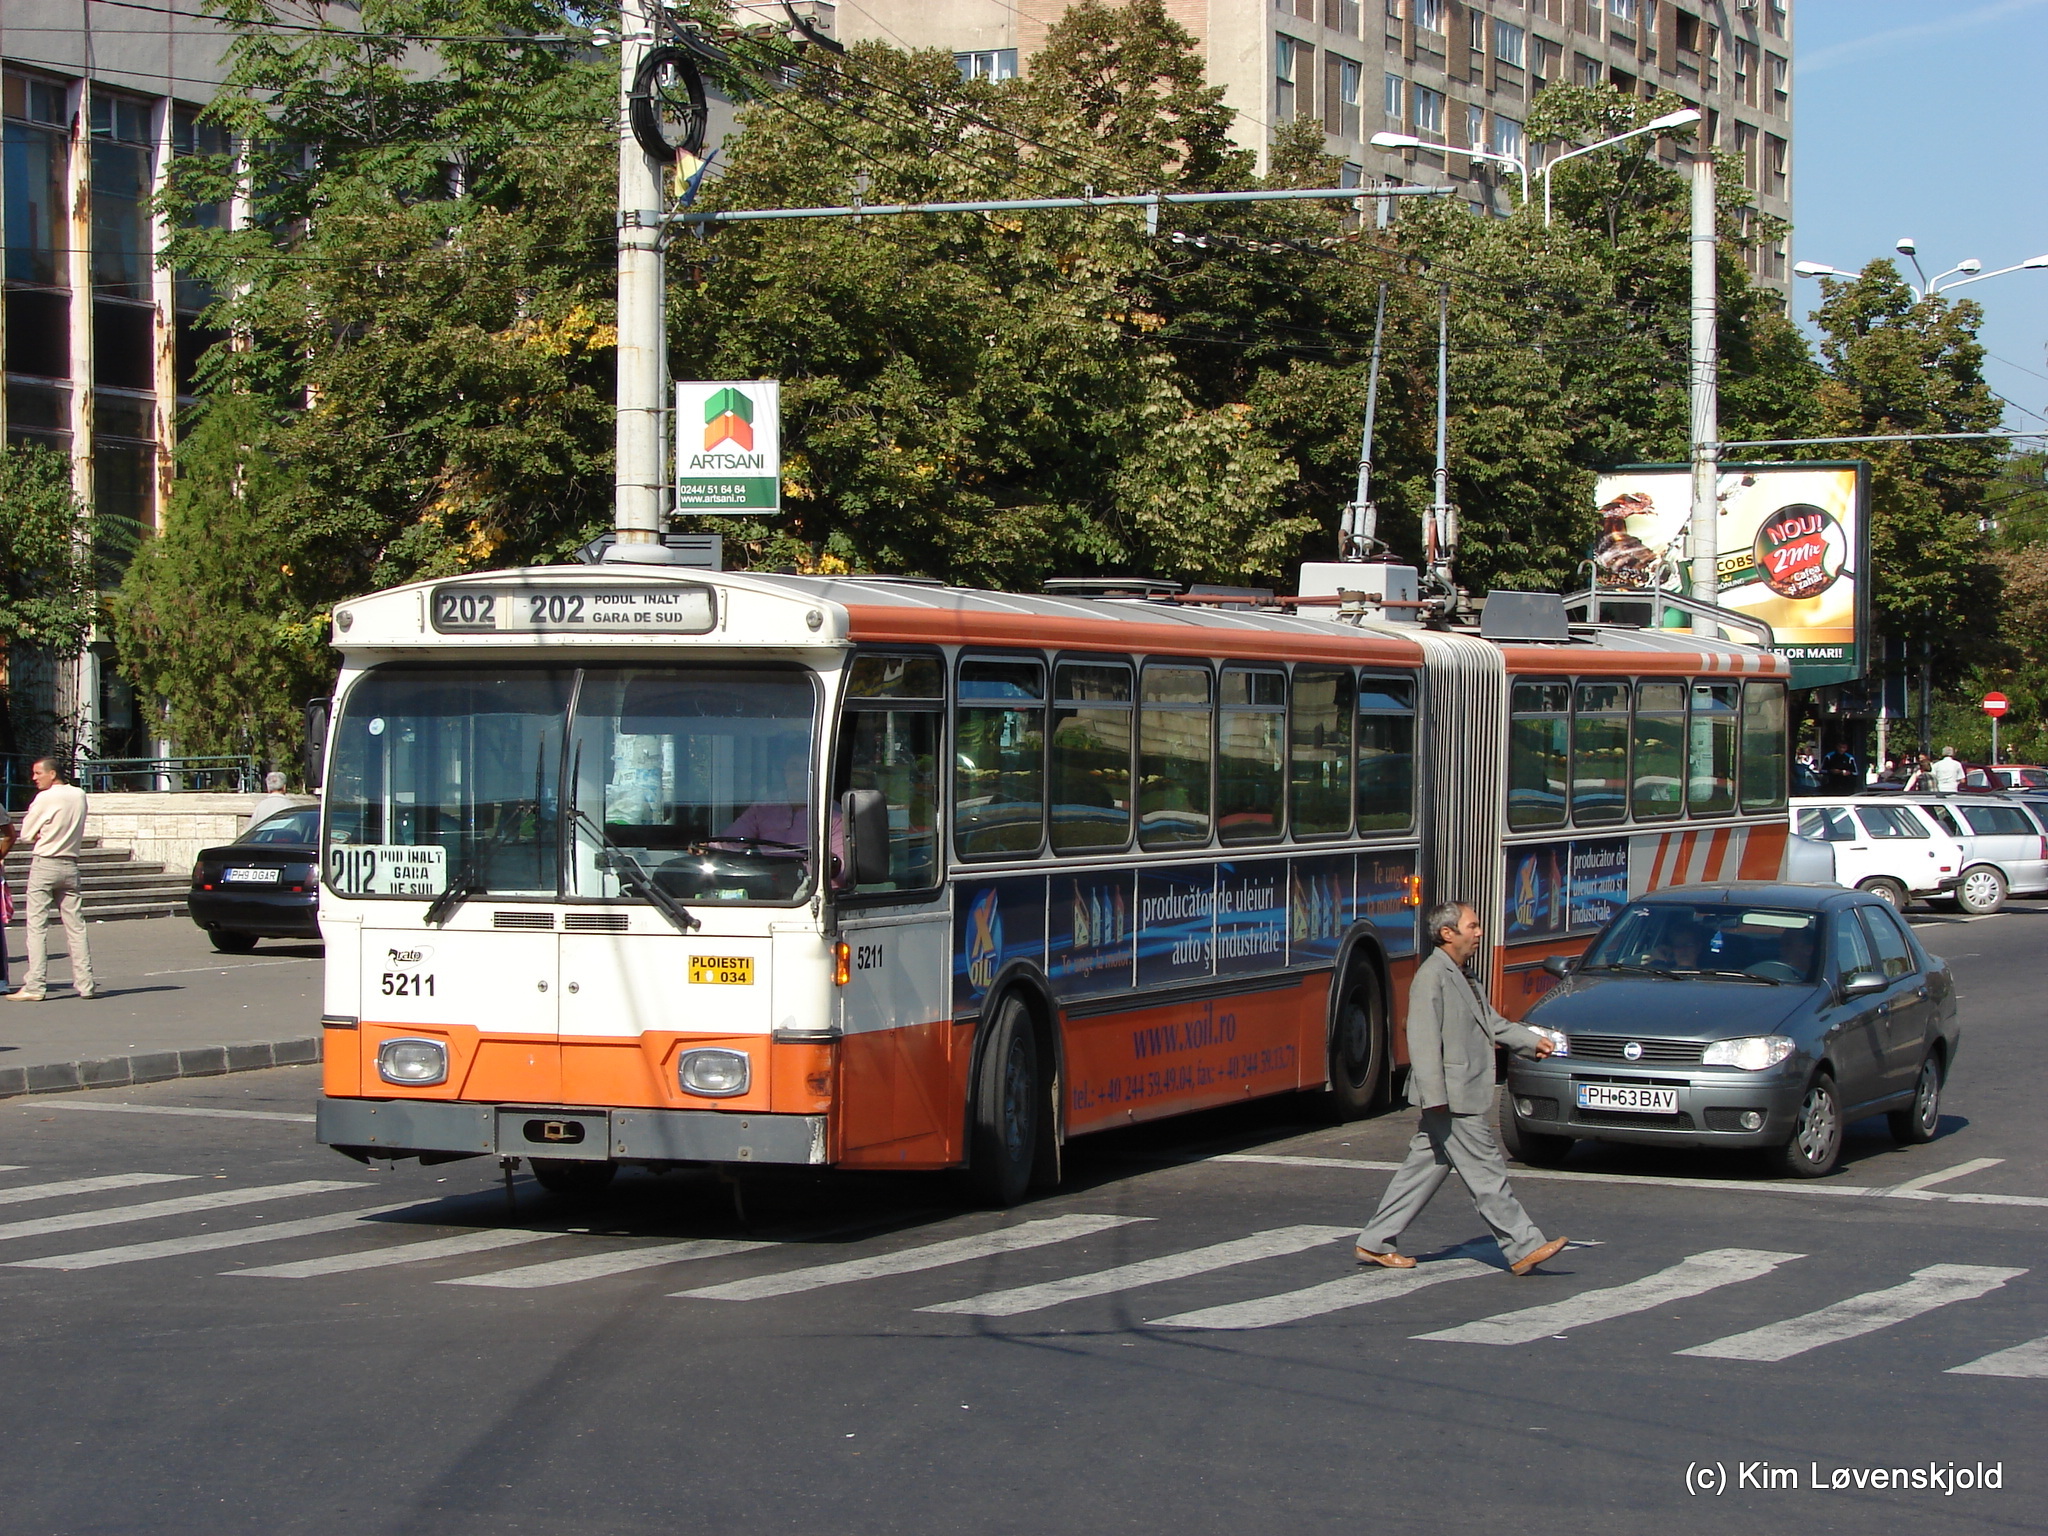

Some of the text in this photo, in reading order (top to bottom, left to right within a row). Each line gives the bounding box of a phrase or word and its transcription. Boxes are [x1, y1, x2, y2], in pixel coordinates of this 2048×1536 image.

[689, 454, 764, 469] ARTSANI
[680, 485, 746, 494] 0244/ 51 64 64
[680, 494, 746, 503] www.artsani.ro
[1766, 514, 1823, 546] NOU!
[1717, 554, 1753, 572] COBS
[1773, 541, 1821, 574] 2Mix
[1793, 564, 1821, 582] Cafea
[441, 595, 496, 623] 202
[530, 595, 585, 623] 202
[594, 594, 680, 605] PODUL INALT
[592, 612, 683, 624] GARA DE SUD
[1807, 648, 1843, 659] MARI!
[1616, 845, 1626, 865] de
[394, 866, 429, 879] GARA
[1598, 876, 1615, 894] auto
[1142, 877, 1274, 933] producător de uleiuri
[1572, 900, 1611, 924] industriale
[1172, 933, 1200, 965] auto
[1217, 920, 1280, 959] industriale
[692, 957, 749, 969] PLOIESTI
[857, 944, 883, 970] 5211
[720, 972, 746, 983] 034
[971, 956, 994, 987] OIL
[382, 973, 434, 996] 5211
[1132, 1001, 1237, 1061] www.xoil.ro
[1125, 1073, 1144, 1100] 244
